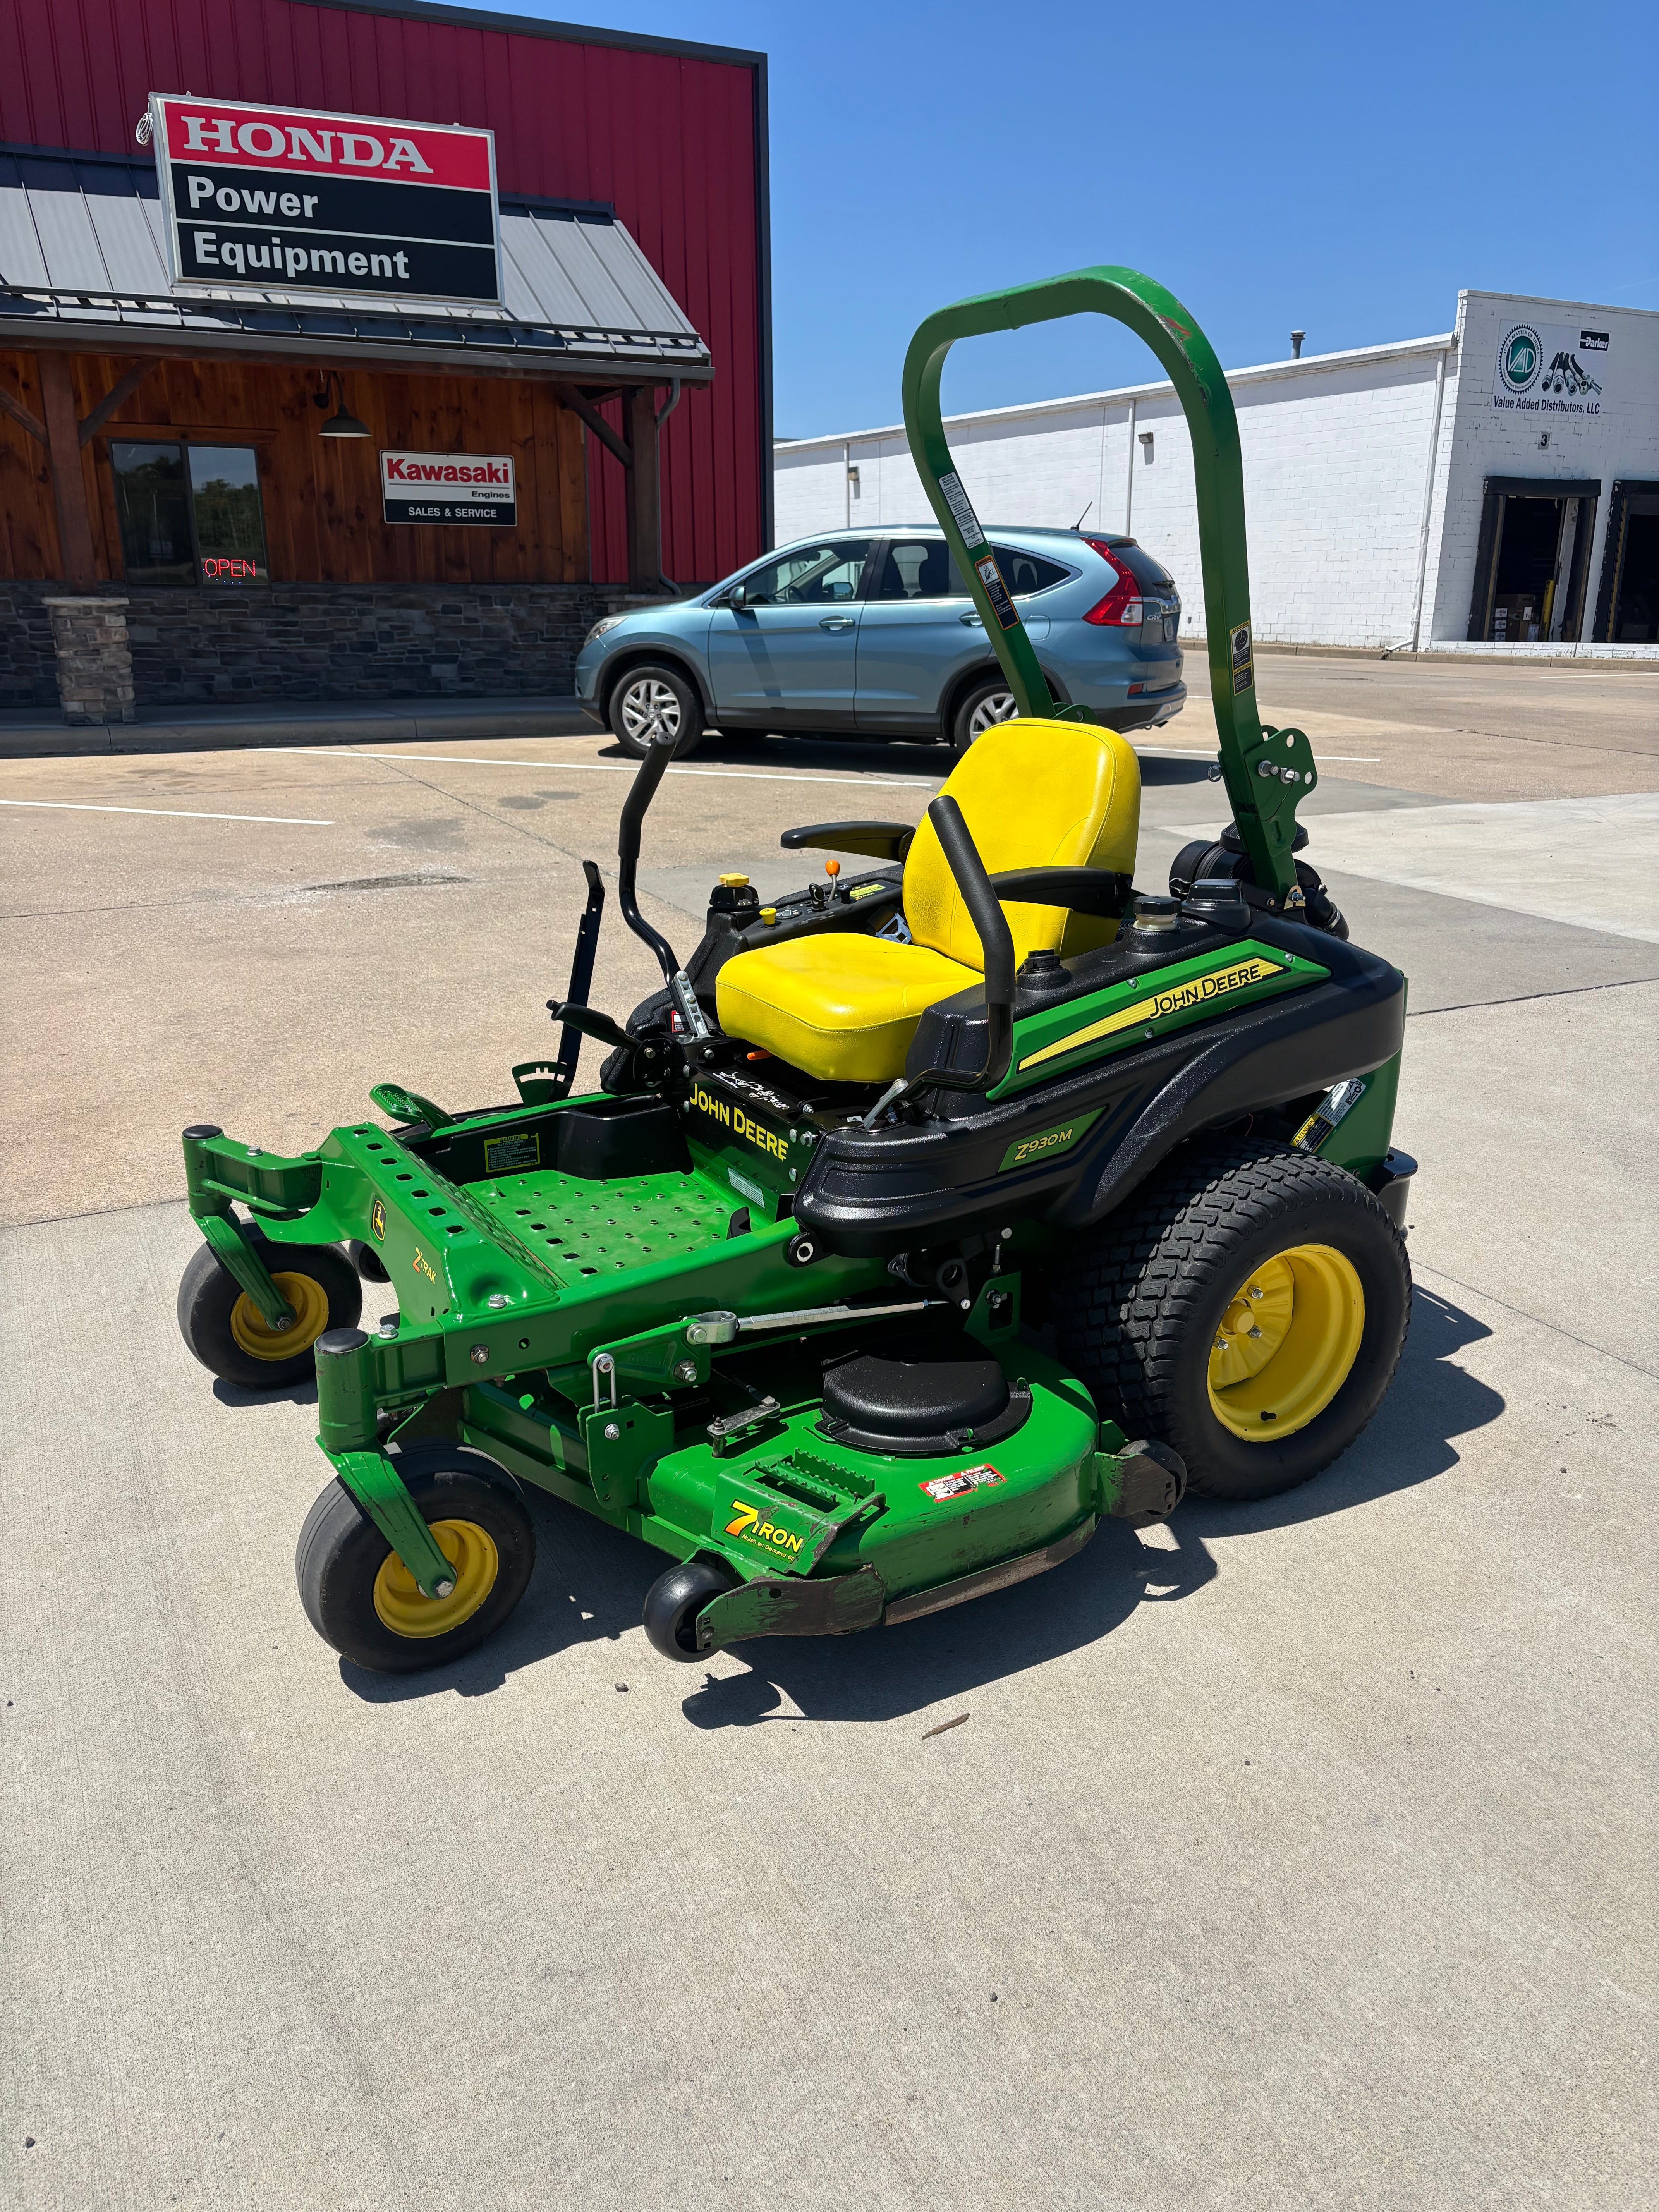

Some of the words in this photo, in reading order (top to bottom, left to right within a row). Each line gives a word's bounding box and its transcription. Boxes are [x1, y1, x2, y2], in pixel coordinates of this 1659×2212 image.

[181, 116, 434, 174] HONDA
[187, 175, 319, 218] Power
[193, 231, 410, 279] Equipment
[1512, 330, 1528, 339] MATTER
[1585, 336, 1608, 349] Parker
[1494, 395, 1514, 409] Value
[1516, 397, 1539, 410] Added
[1541, 399, 1585, 415] Distributors,
[1587, 402, 1600, 414] LLC
[1540, 434, 1548, 446] 3
[386, 458, 509, 483] Kawasaki
[472, 491, 510, 499] Engines
[408, 507, 441, 517] SALES
[445, 508, 452, 517] &
[455, 508, 497, 518] SERVICE
[204, 558, 256, 577] OPEN
[1151, 986, 1199, 1018] JOHN
[1202, 964, 1262, 999] DEERE
[690, 1083, 730, 1127] JOHN
[734, 1106, 789, 1161] DEERE
[1014, 1128, 1073, 1161] Z930M
[742, 1534, 757, 1544] Mulch
[765, 1544, 787, 1558] Demand
